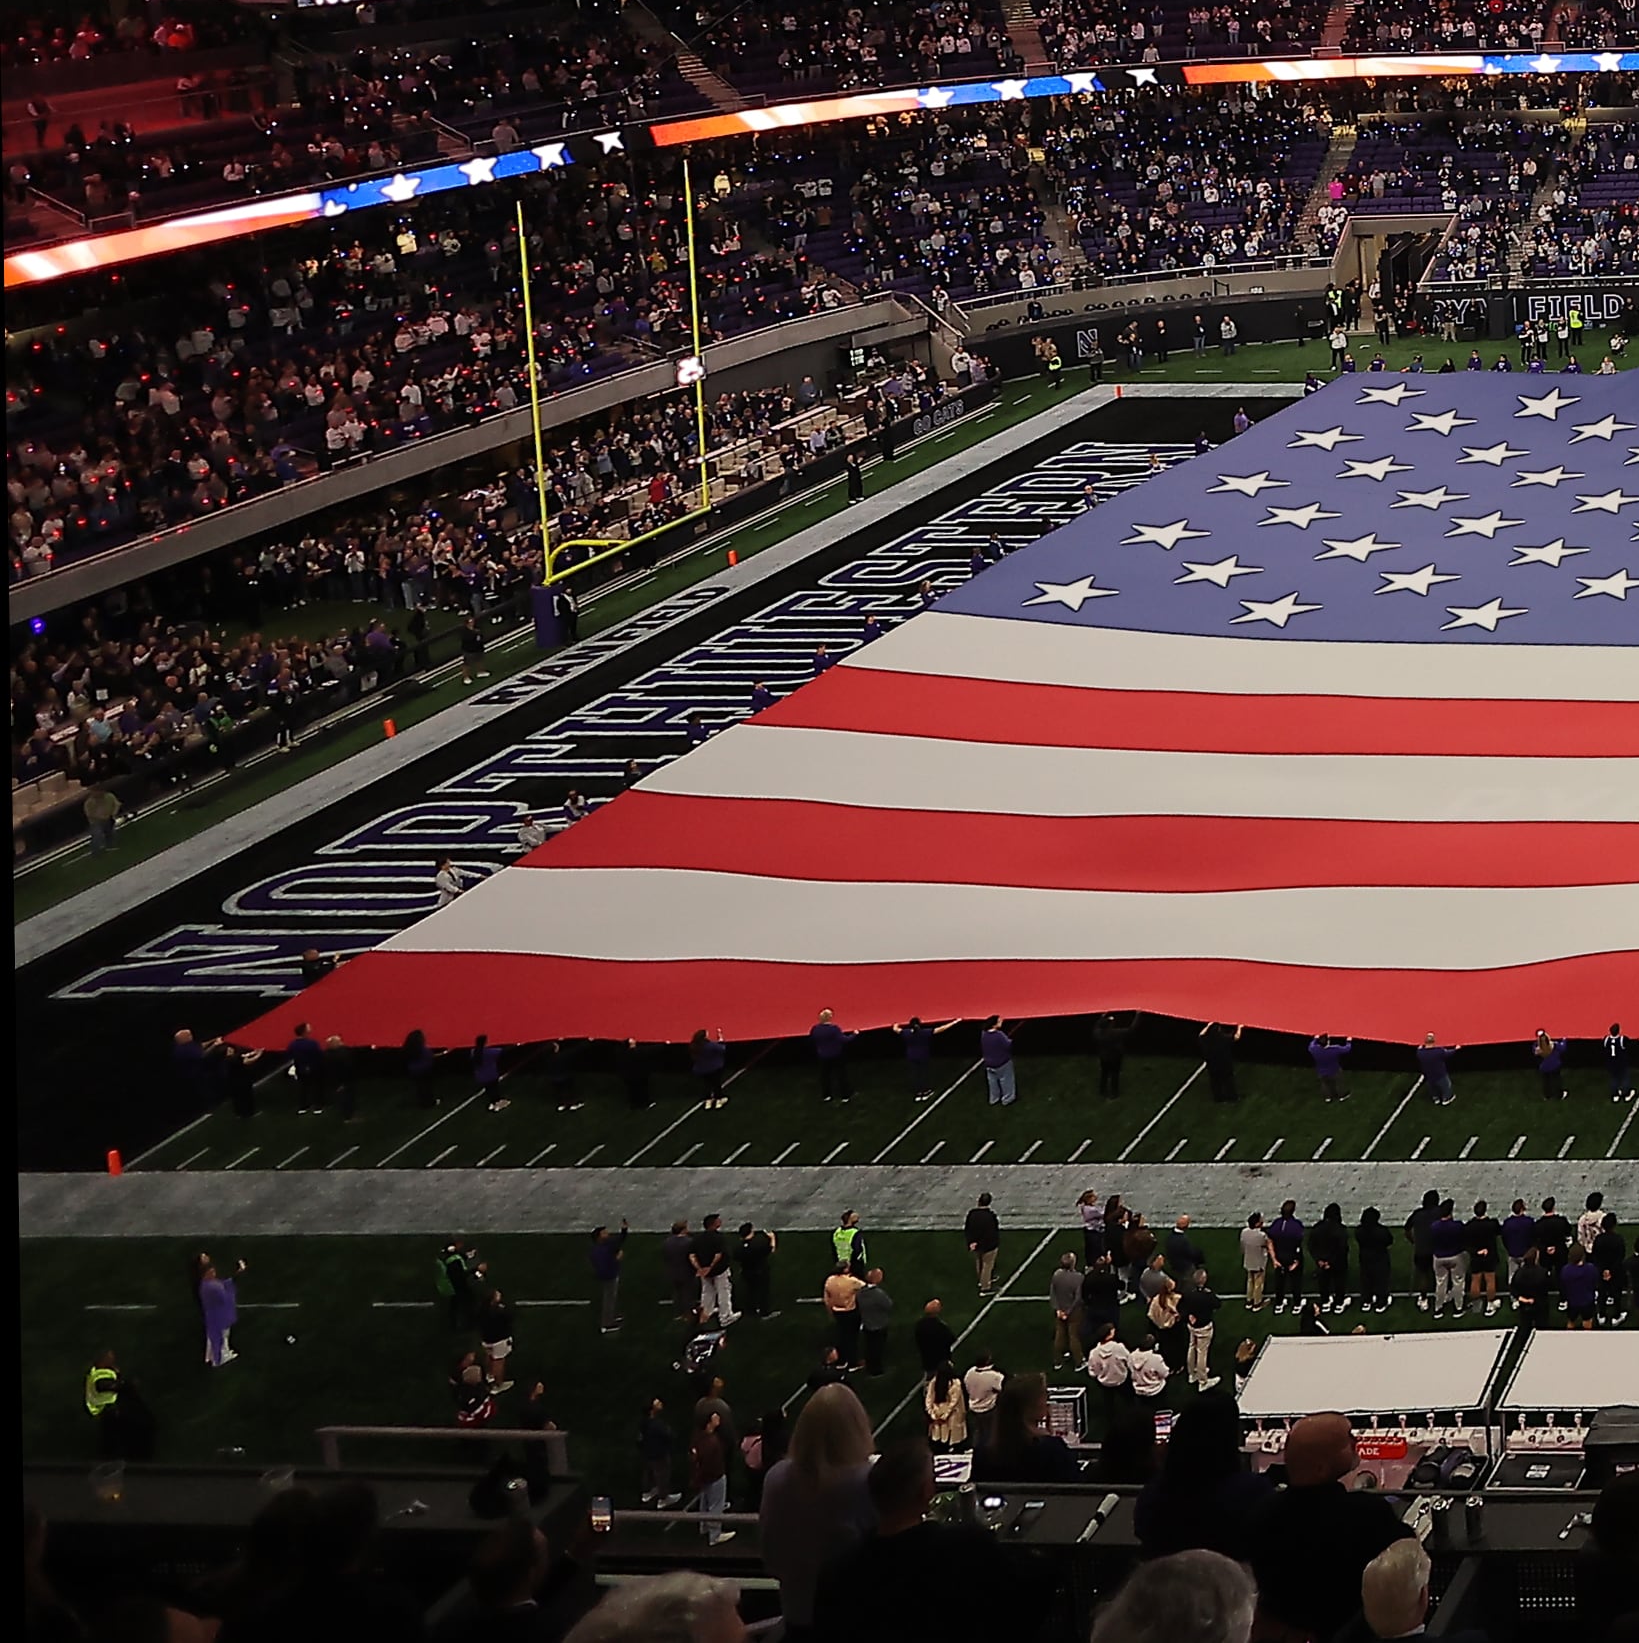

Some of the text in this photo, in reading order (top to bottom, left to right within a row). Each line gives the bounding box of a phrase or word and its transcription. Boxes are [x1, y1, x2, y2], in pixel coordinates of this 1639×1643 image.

[1528, 293, 1625, 322] FIELD
[469, 586, 730, 706] RYAN FIELD
